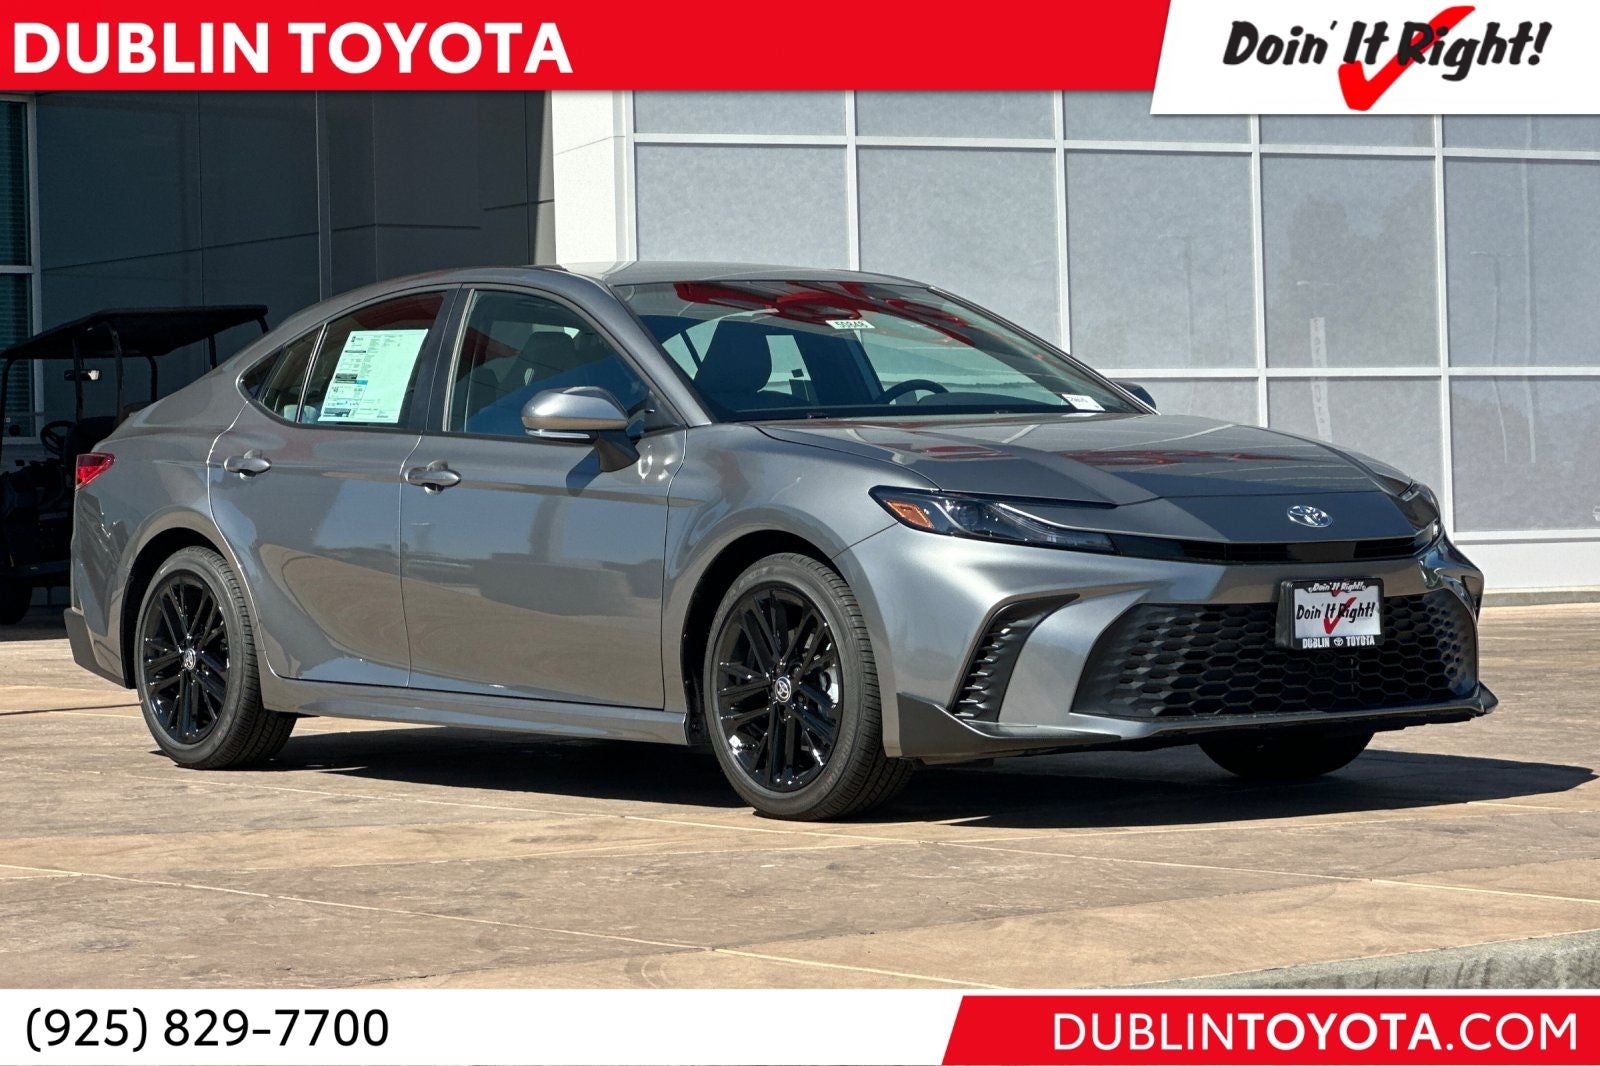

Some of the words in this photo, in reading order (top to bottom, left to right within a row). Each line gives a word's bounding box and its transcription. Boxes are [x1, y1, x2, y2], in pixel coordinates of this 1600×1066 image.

[1296, 603, 1324, 620] Doin'
[1325, 603, 1336, 618] It
[1338, 602, 1375, 623] Right!
[1302, 638, 1330, 649] DUBLIN
[1345, 635, 1375, 647] TOYOTA
